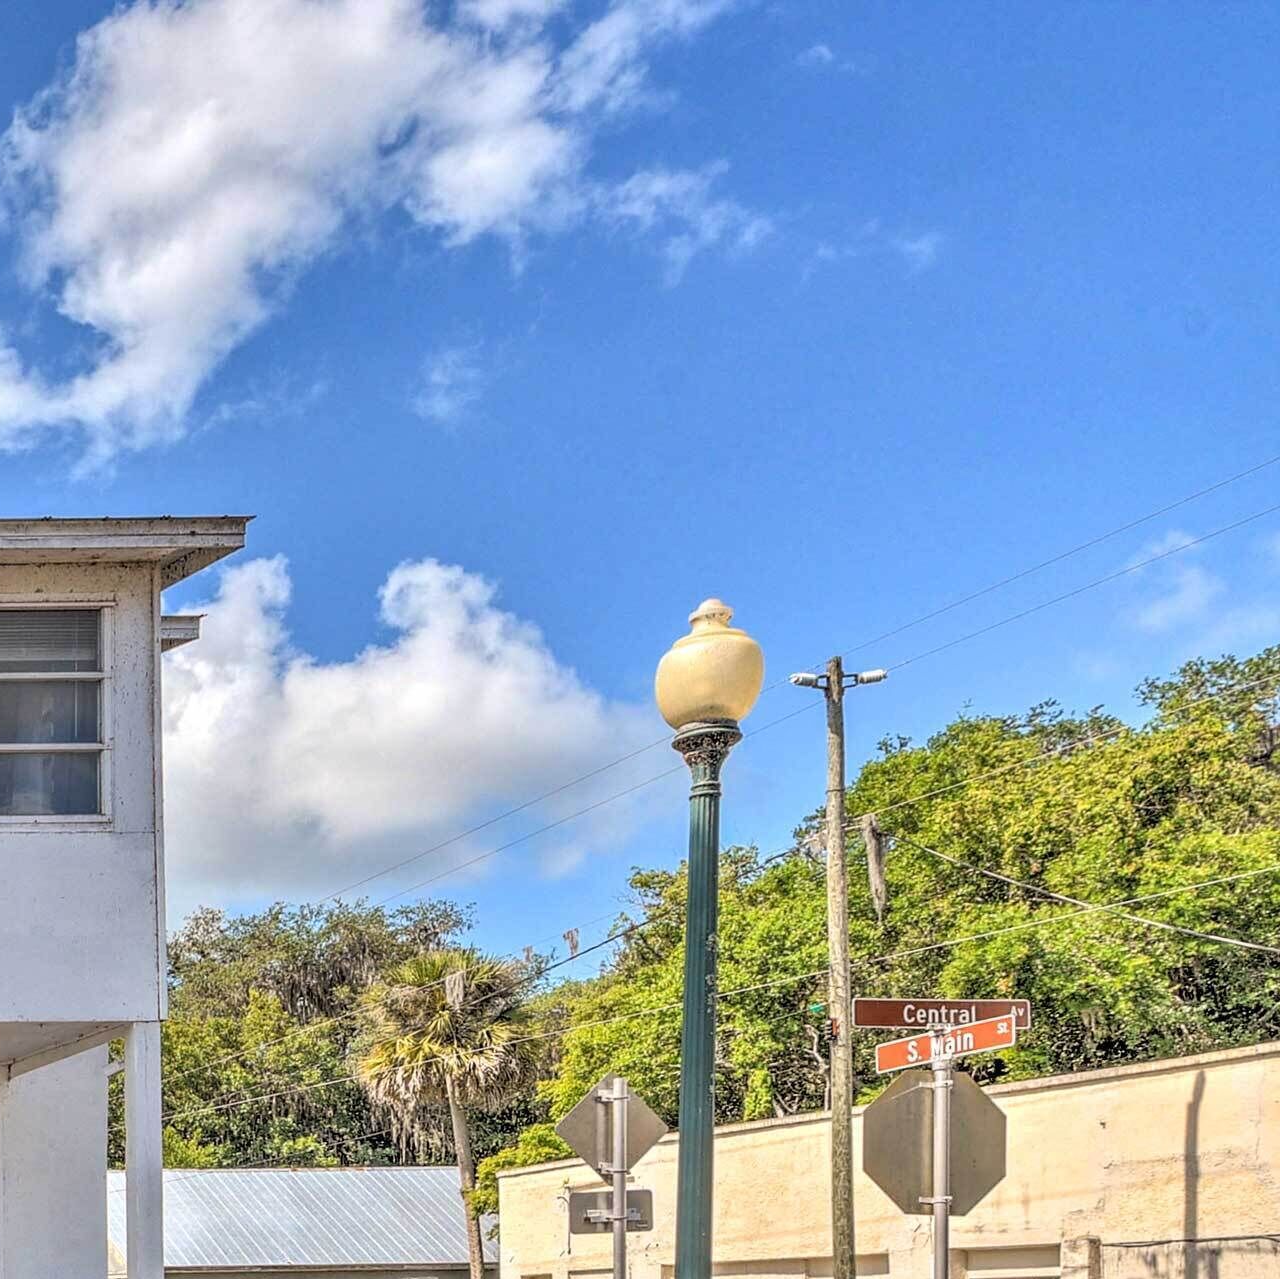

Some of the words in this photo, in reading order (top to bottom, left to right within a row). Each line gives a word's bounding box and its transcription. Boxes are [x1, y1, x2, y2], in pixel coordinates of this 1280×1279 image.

[903, 1004, 976, 1024] Central
[907, 1040, 923, 1062] S.
[931, 1030, 974, 1059] Main
